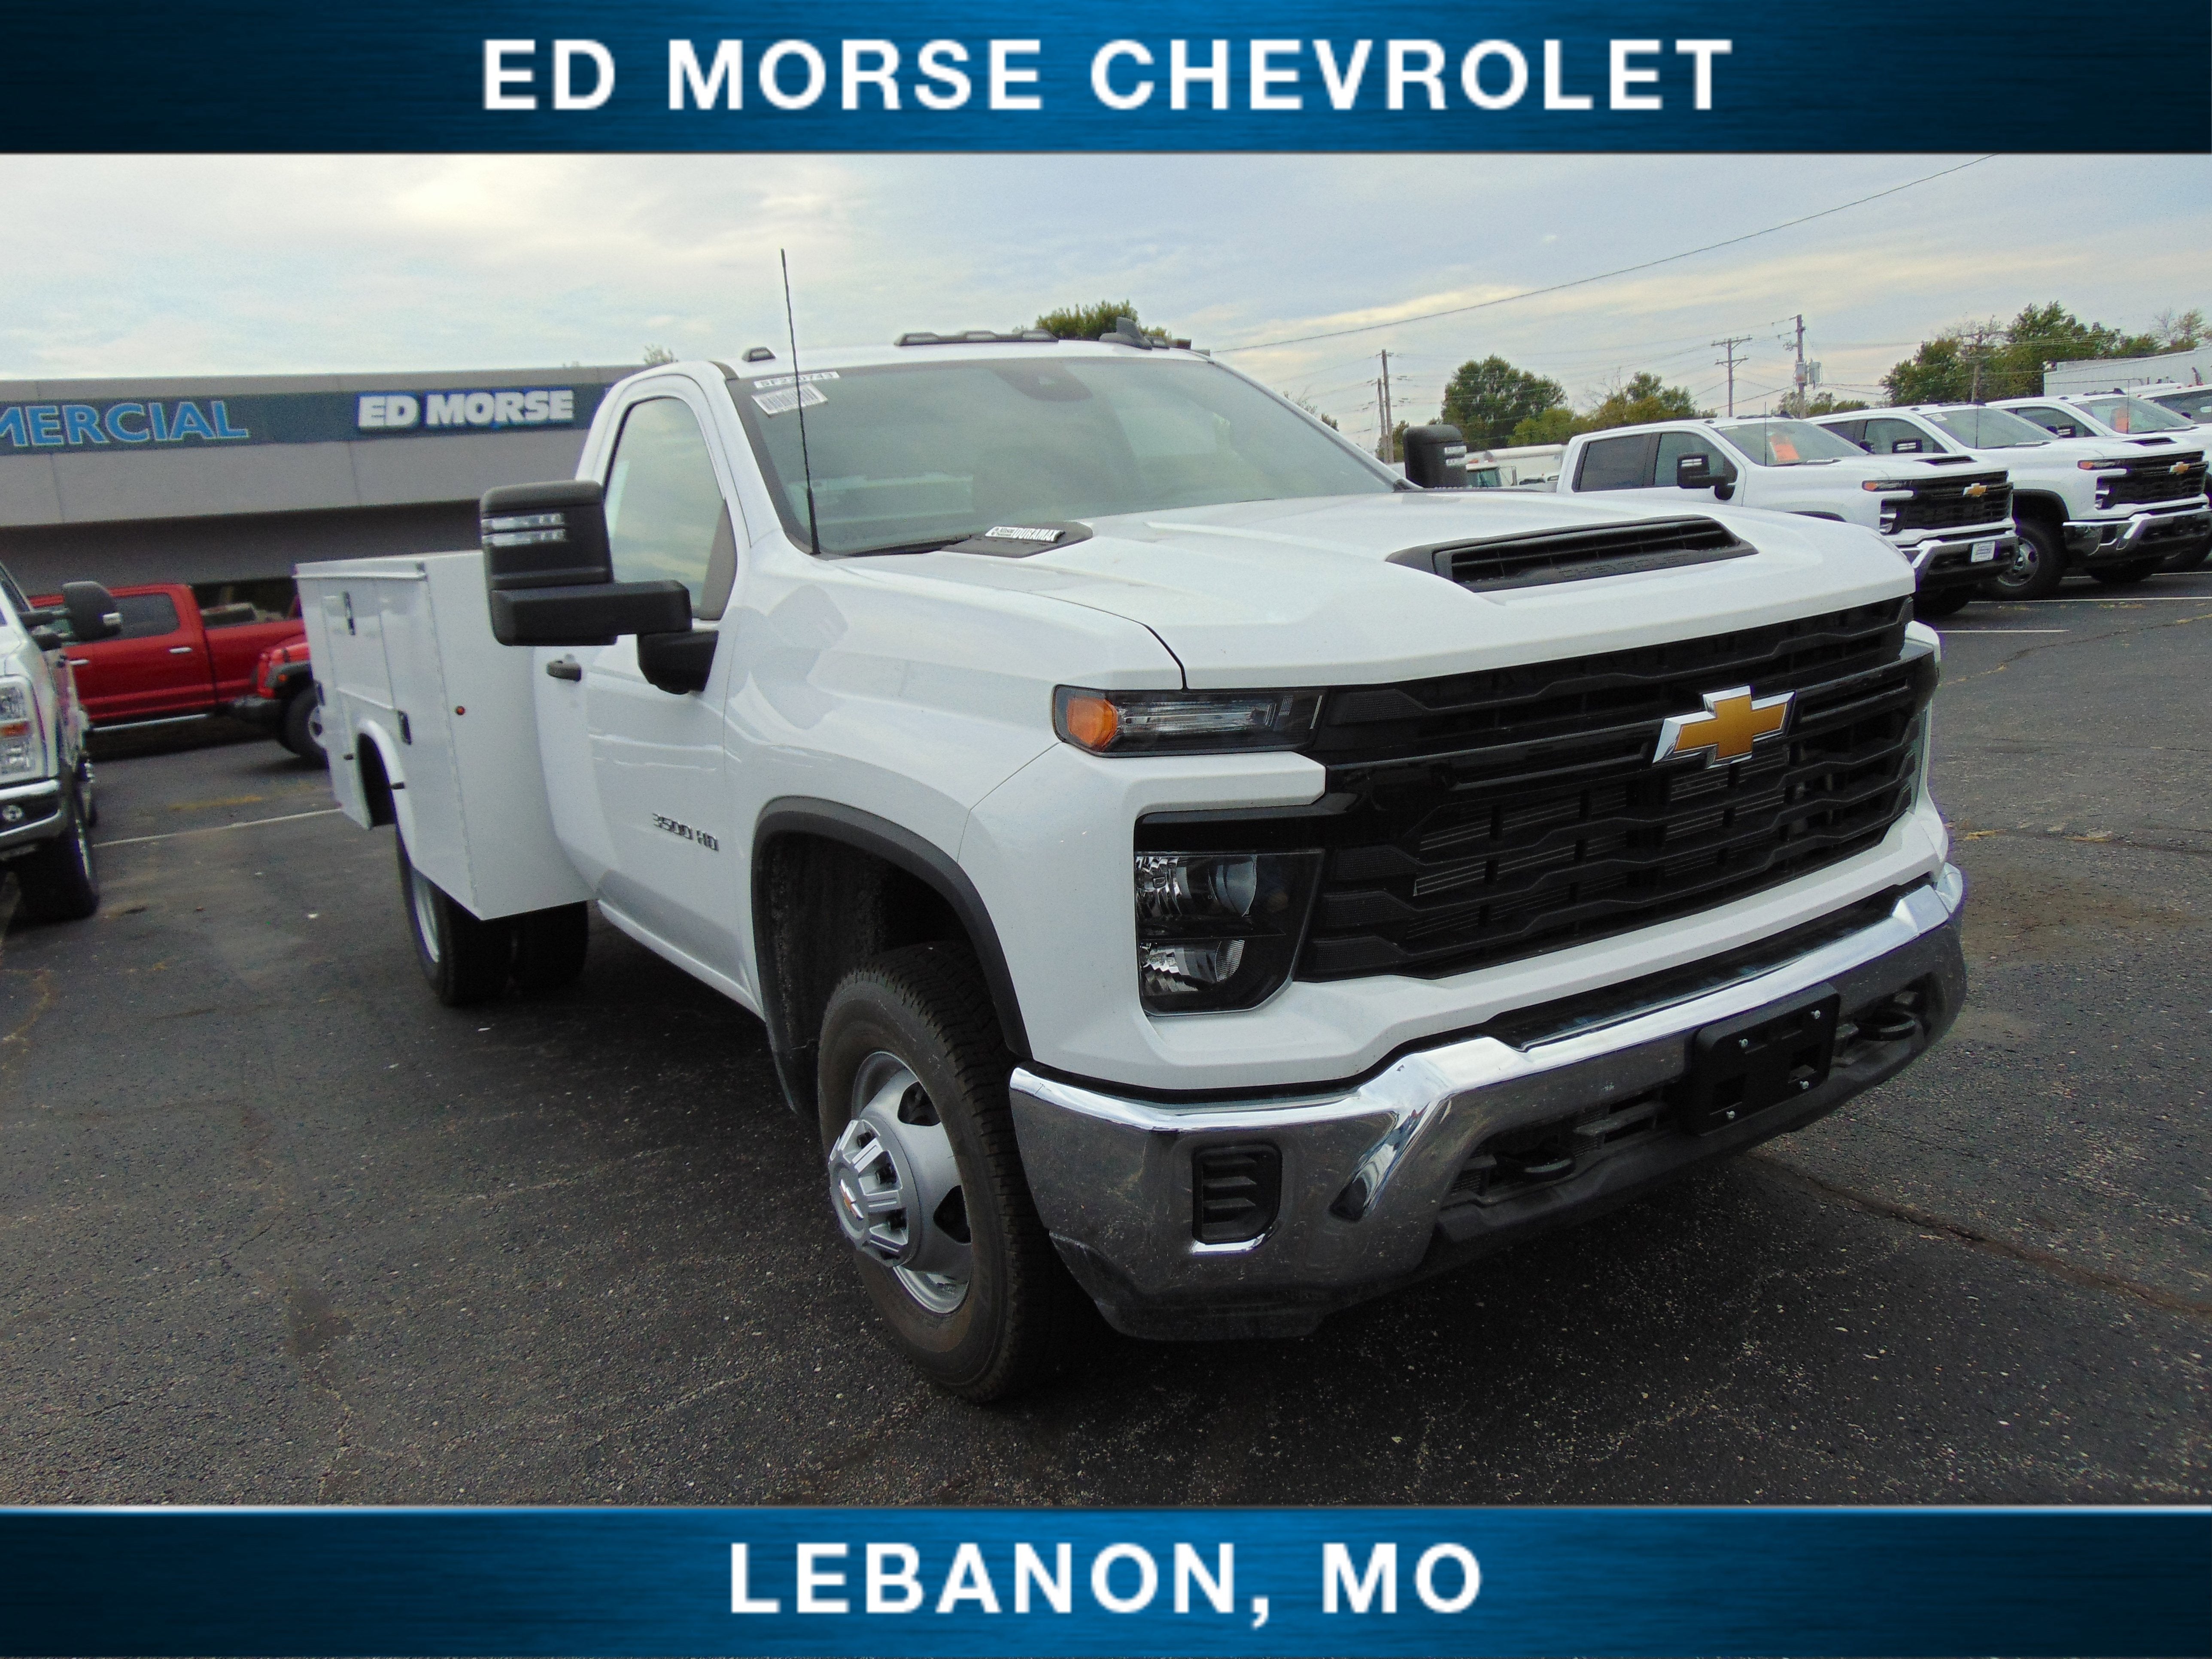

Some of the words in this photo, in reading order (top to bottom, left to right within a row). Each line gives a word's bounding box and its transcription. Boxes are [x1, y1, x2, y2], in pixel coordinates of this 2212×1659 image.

[359, 395, 419, 427] ED
[426, 390, 574, 425] MORSE
[1011, 528, 1062, 542] DURAMAX
[653, 812, 694, 840] 3500
[696, 830, 720, 852] HD
